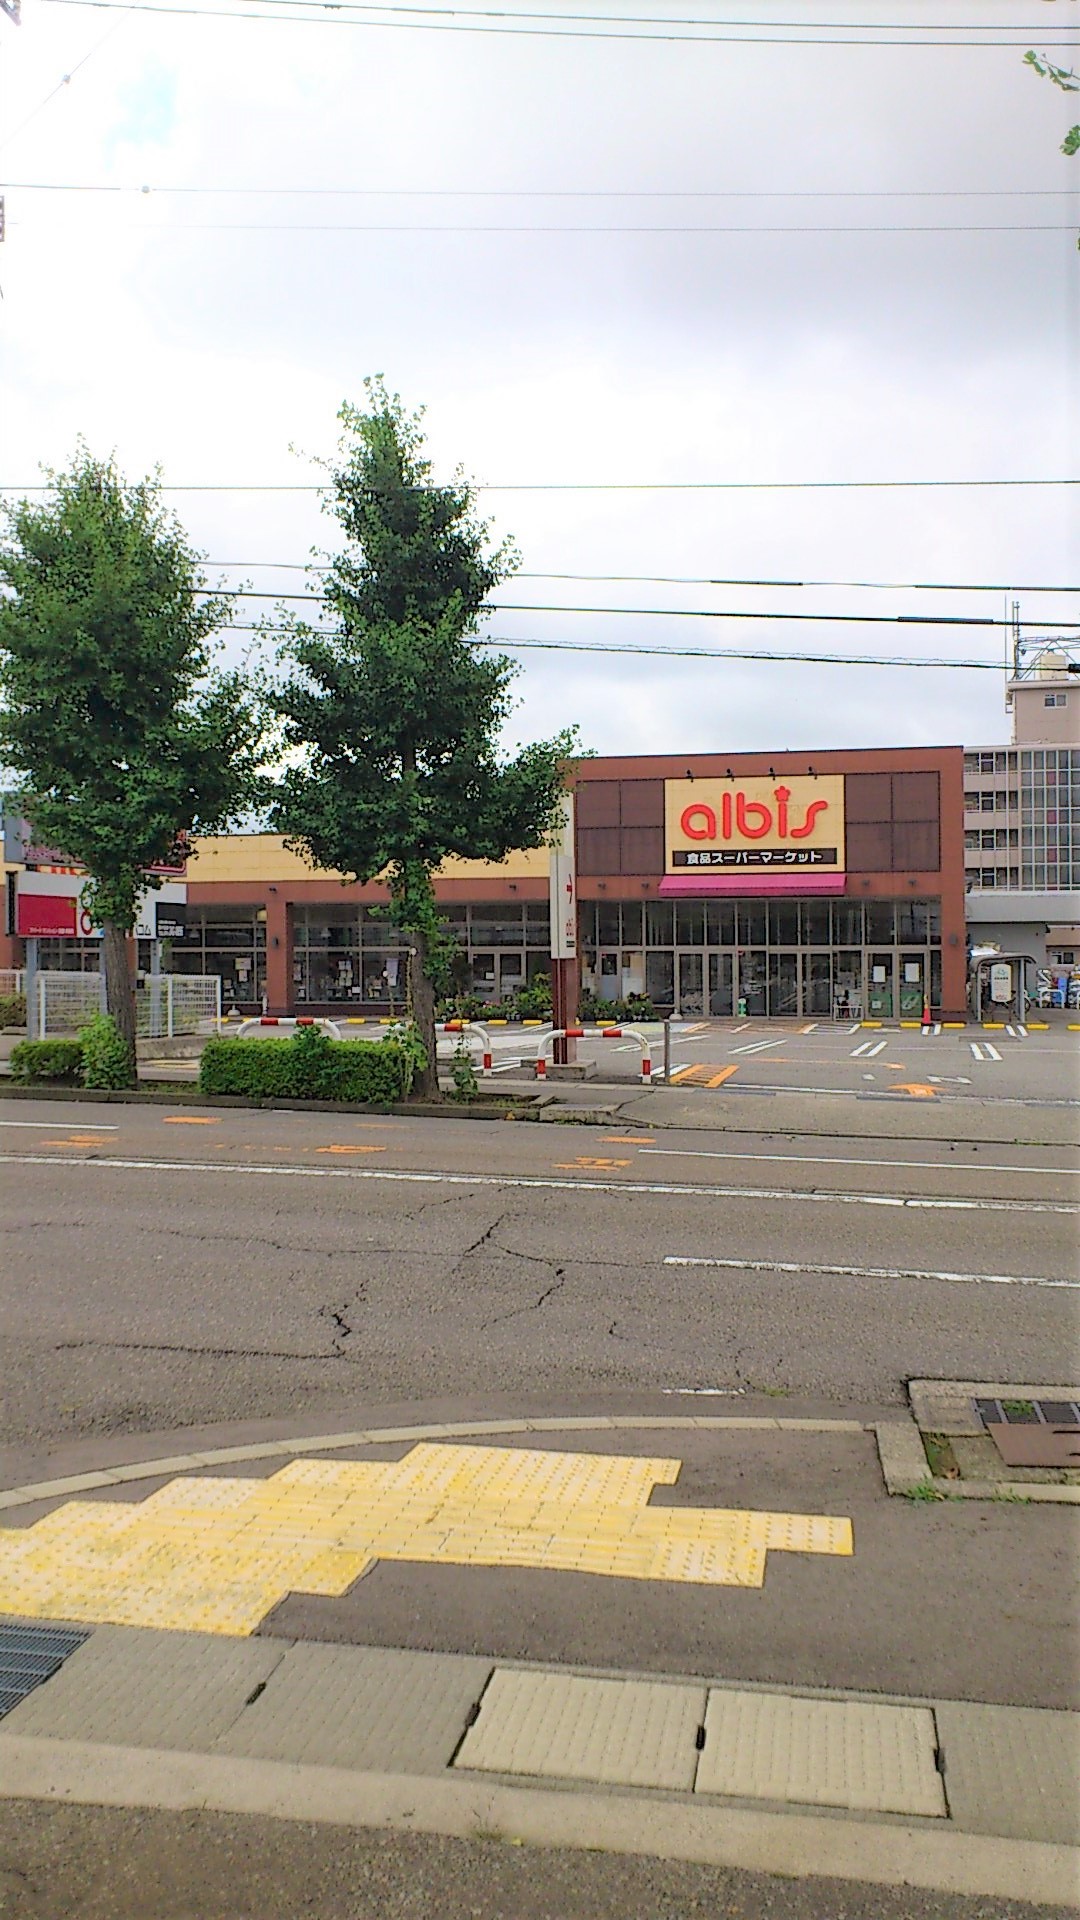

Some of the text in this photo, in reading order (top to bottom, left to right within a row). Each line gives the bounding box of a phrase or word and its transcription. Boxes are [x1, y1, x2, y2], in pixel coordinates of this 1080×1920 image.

[681, 786, 828, 840] albis
[687, 851, 822, 864] 食品スーパーマーケット
